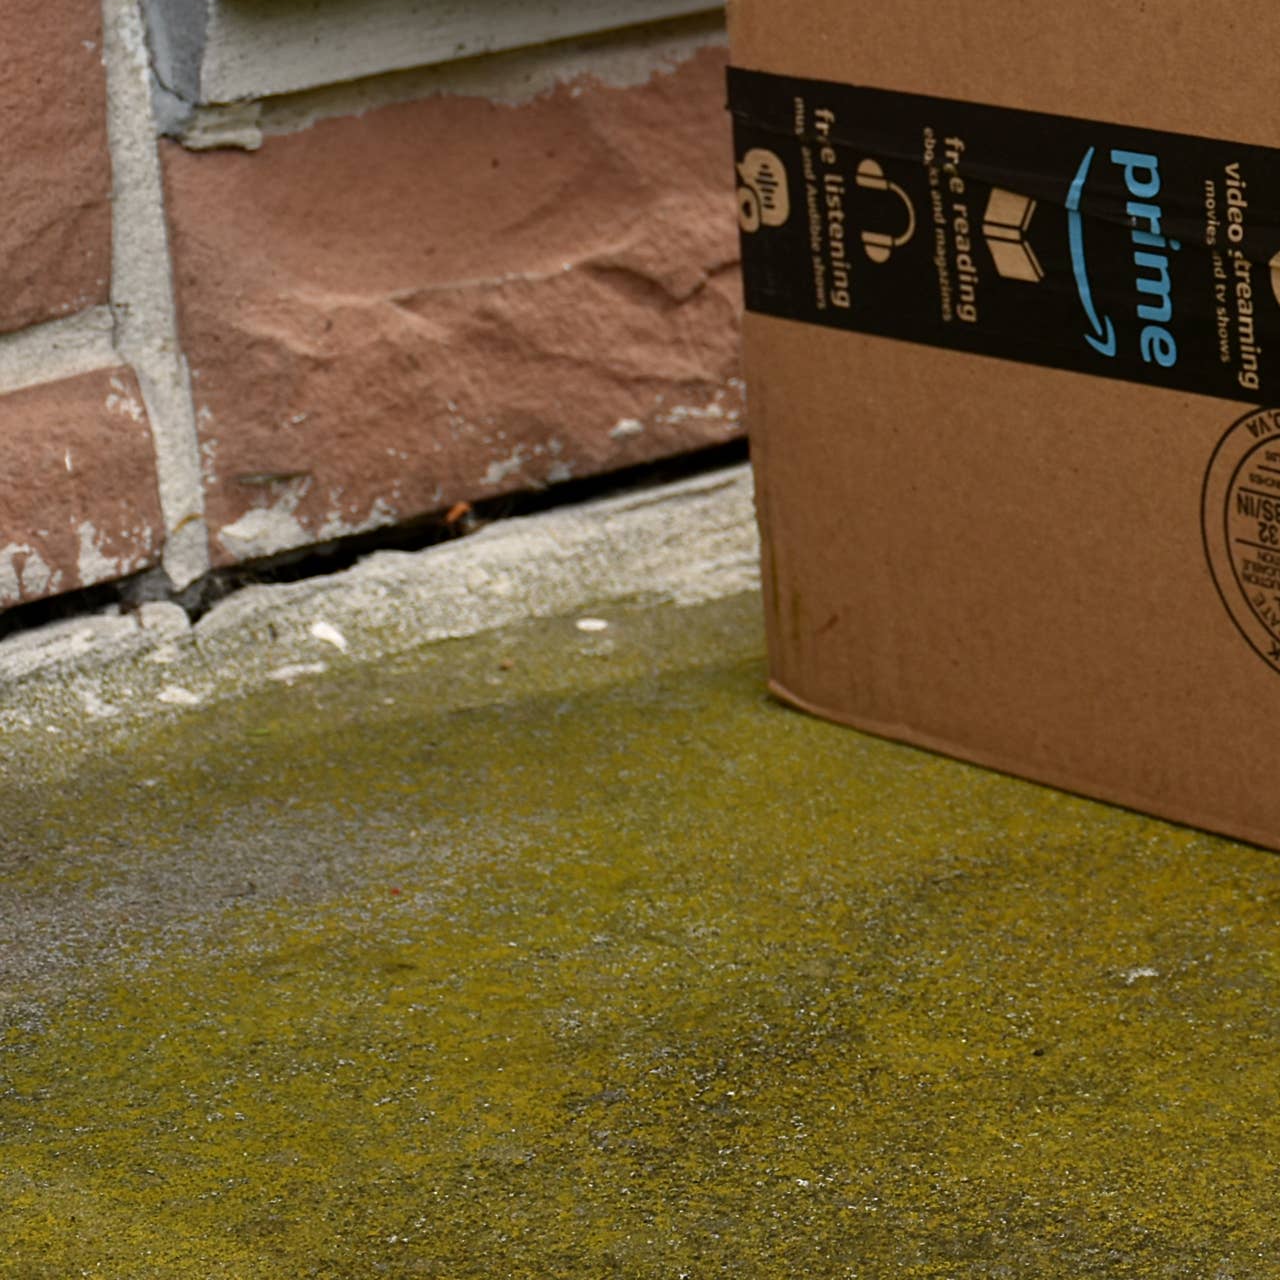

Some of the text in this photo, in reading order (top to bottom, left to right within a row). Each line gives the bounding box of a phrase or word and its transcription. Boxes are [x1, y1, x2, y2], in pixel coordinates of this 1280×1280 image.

[814, 108, 851, 308] fre listening
[924, 127, 939, 186] eboks
[952, 203, 978, 322] reading
[1109, 148, 1184, 368] prime
[1204, 179, 1230, 364] movies nd tv shows
[1225, 162, 1262, 390] video streaming
[1258, 521, 1279, 545] 32
